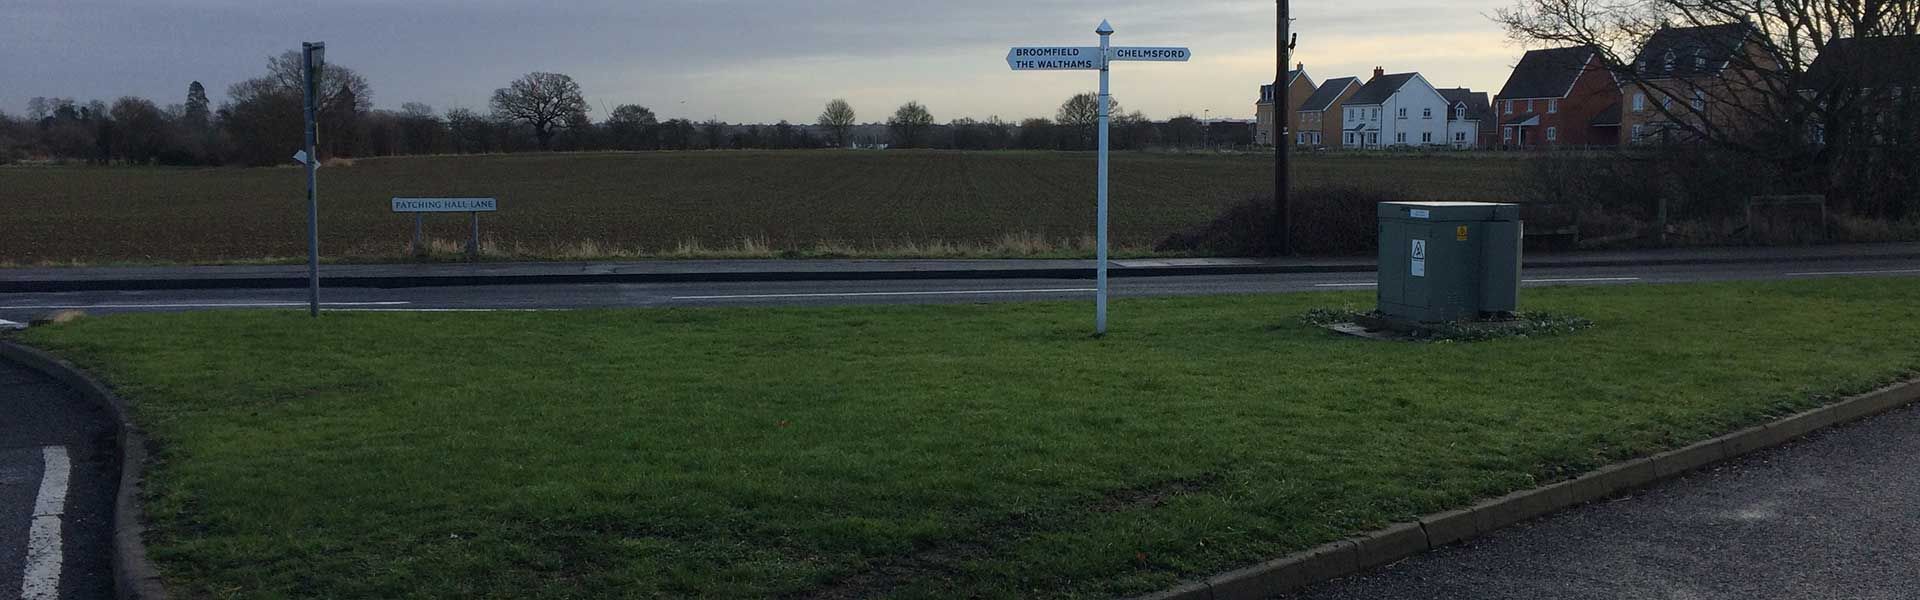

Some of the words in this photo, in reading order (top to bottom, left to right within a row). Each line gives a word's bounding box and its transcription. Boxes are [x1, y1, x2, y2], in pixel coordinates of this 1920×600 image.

[1016, 48, 1080, 57] BROOMFIELD
[1117, 49, 1185, 58] CHELMSFORD
[1016, 60, 1035, 69] THE
[1038, 60, 1092, 69] WALTHAMS
[395, 201, 442, 209] PATCHING
[444, 200, 468, 209] HALL
[470, 200, 493, 208] LANE
